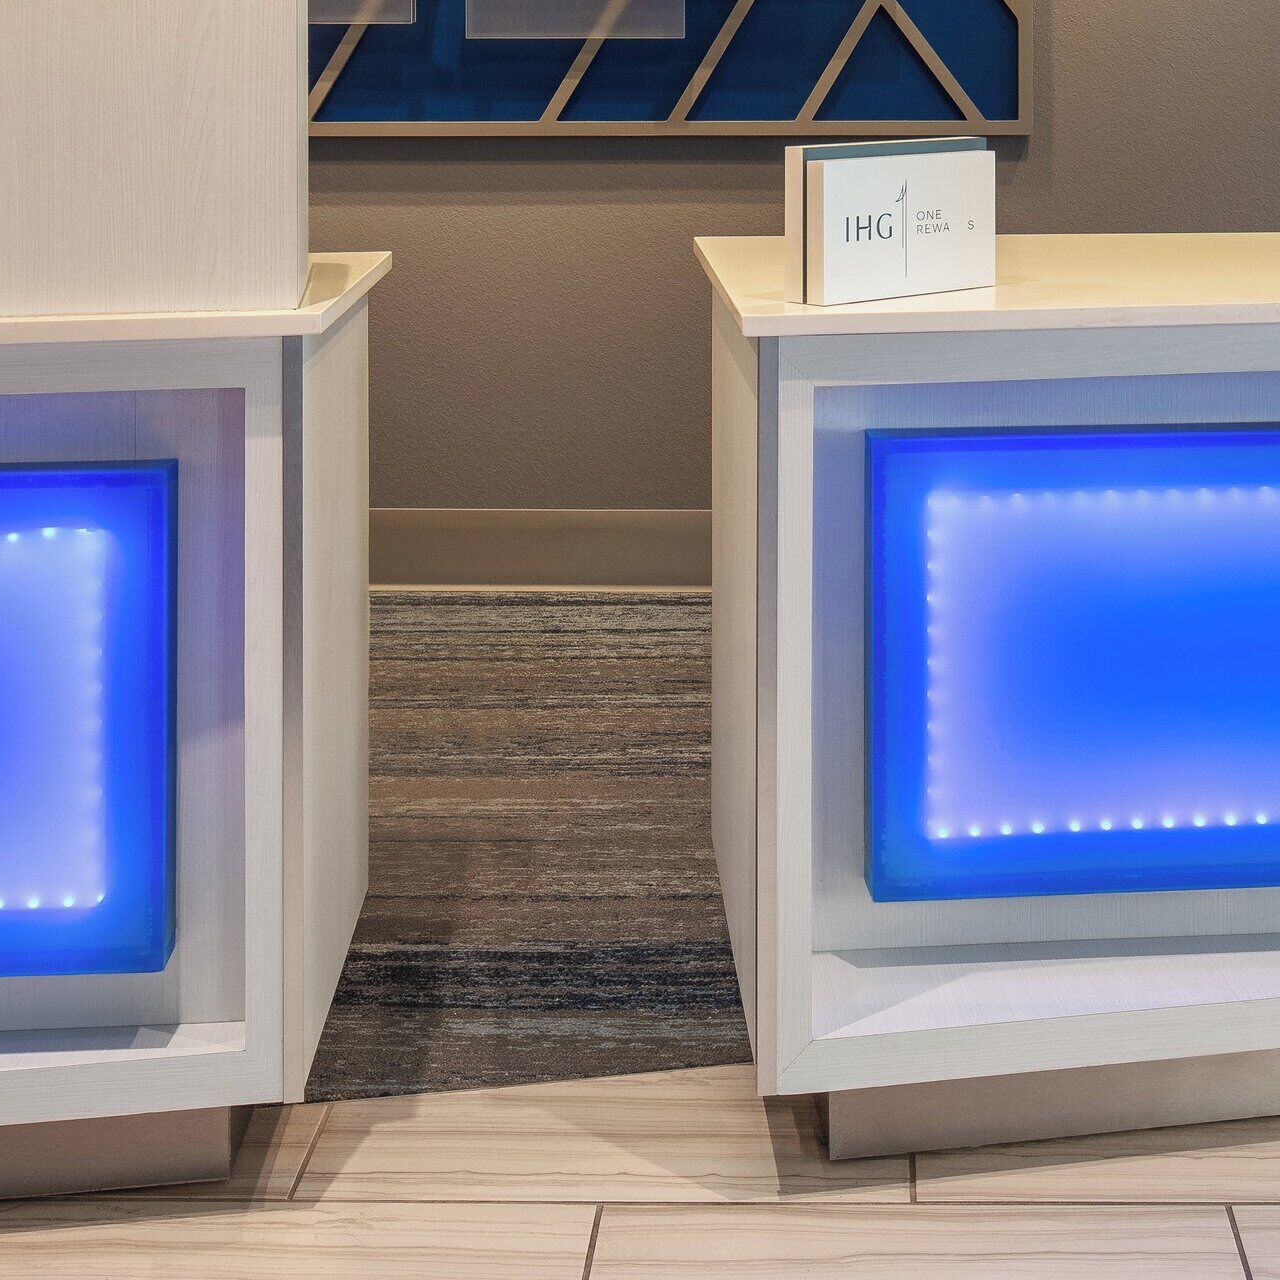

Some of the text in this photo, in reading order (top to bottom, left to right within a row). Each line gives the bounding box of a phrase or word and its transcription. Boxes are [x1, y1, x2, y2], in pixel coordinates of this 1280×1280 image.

[916, 209, 942, 221] ONE
[845, 213, 893, 243] IHG
[916, 220, 975, 235] REWAS
